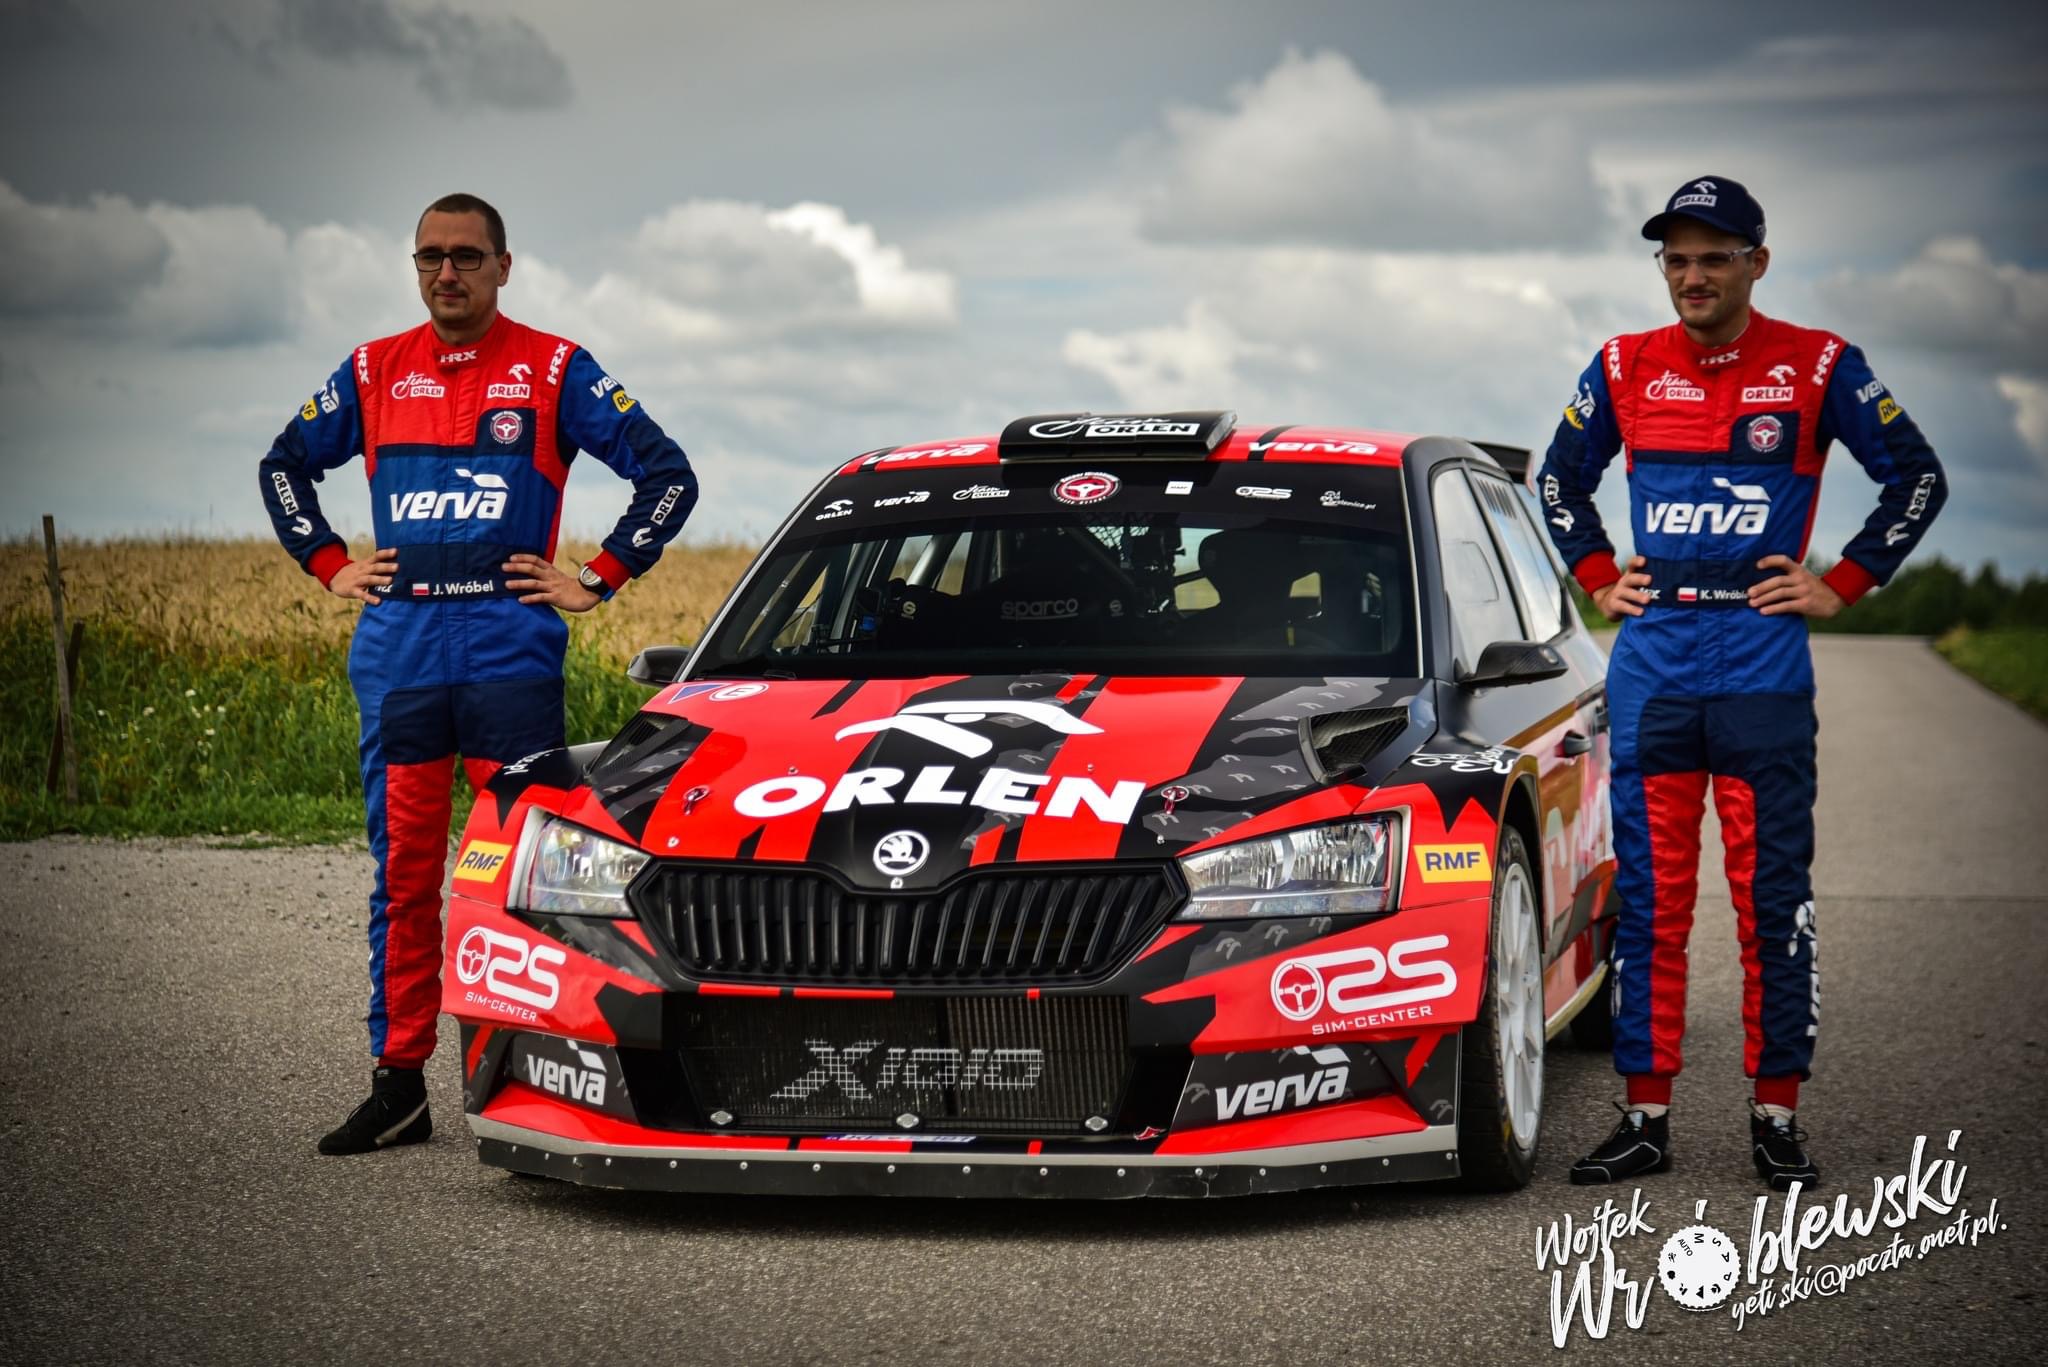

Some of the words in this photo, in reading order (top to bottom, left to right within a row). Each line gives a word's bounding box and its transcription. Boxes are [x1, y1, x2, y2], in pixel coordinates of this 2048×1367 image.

[358, 346, 370, 384] HRX
[440, 350, 477, 363] HRX
[547, 342, 568, 385] HRX
[1812, 339, 1839, 385] HRX
[412, 386, 443, 396] ORLEN
[489, 385, 529, 397] ORLEN
[1668, 389, 1703, 399] ORLEN
[1744, 388, 1792, 400] ORLEN
[1094, 423, 1191, 433] ORLEN
[863, 444, 989, 466] verva
[1249, 441, 1378, 455] verva
[273, 473, 298, 513] ORLEN
[874, 494, 931, 508] verva
[390, 491, 508, 522] verva
[815, 509, 853, 521] ORLEN
[1646, 502, 1770, 534] verva
[433, 584, 444, 595] J.
[446, 580, 494, 594] Wróbel
[1700, 589, 1713, 600] K.
[1001, 599, 1079, 620] sparco
[734, 766, 1146, 825] ORLEN
[461, 851, 504, 871] RMF
[1424, 851, 1482, 871] RMF
[464, 991, 537, 1022] SIM-CENTER
[1312, 1005, 1433, 1035] SIM-CENTER
[527, 1053, 606, 1105] verva
[1215, 1065, 1349, 1121] verva
